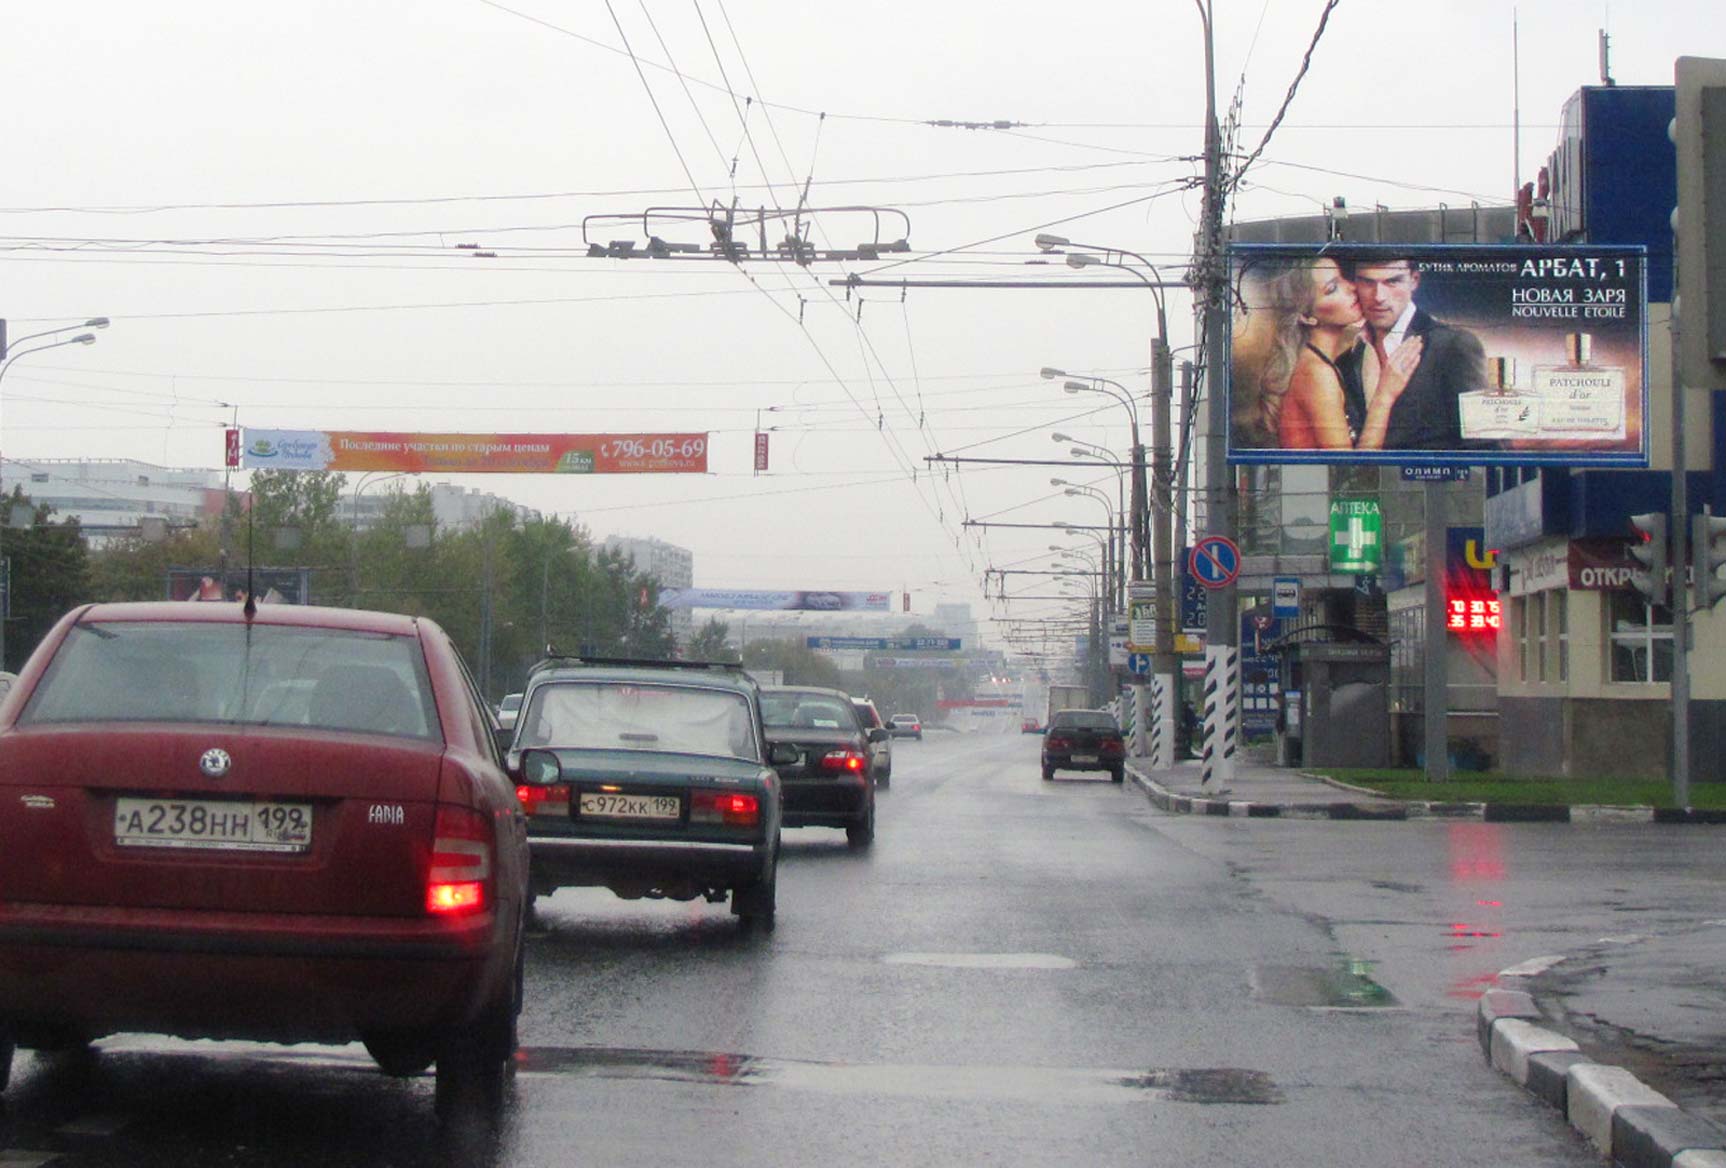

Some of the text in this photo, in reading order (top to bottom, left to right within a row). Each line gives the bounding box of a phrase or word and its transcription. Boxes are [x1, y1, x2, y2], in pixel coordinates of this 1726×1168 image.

[1418, 258, 1625, 281] БУТИК АРОМАТОВ АРБАТ, 1
[1512, 288, 1626, 302] НОВАЯ ЗАРЯ
[1512, 307, 1626, 317] NOUVELLE ETOILE
[1550, 378, 1611, 387] PATCHOULI
[340, 438, 550, 456] Последние участки по старым ценам
[612, 439, 704, 458] 796-05-69
[1405, 467, 1451, 476] ОЛИМП
[1330, 502, 1380, 515] АПТЕКА
[653, 797, 676, 811] 199
[127, 804, 303, 836] А238НН 199
[368, 804, 404, 824] FABIA
